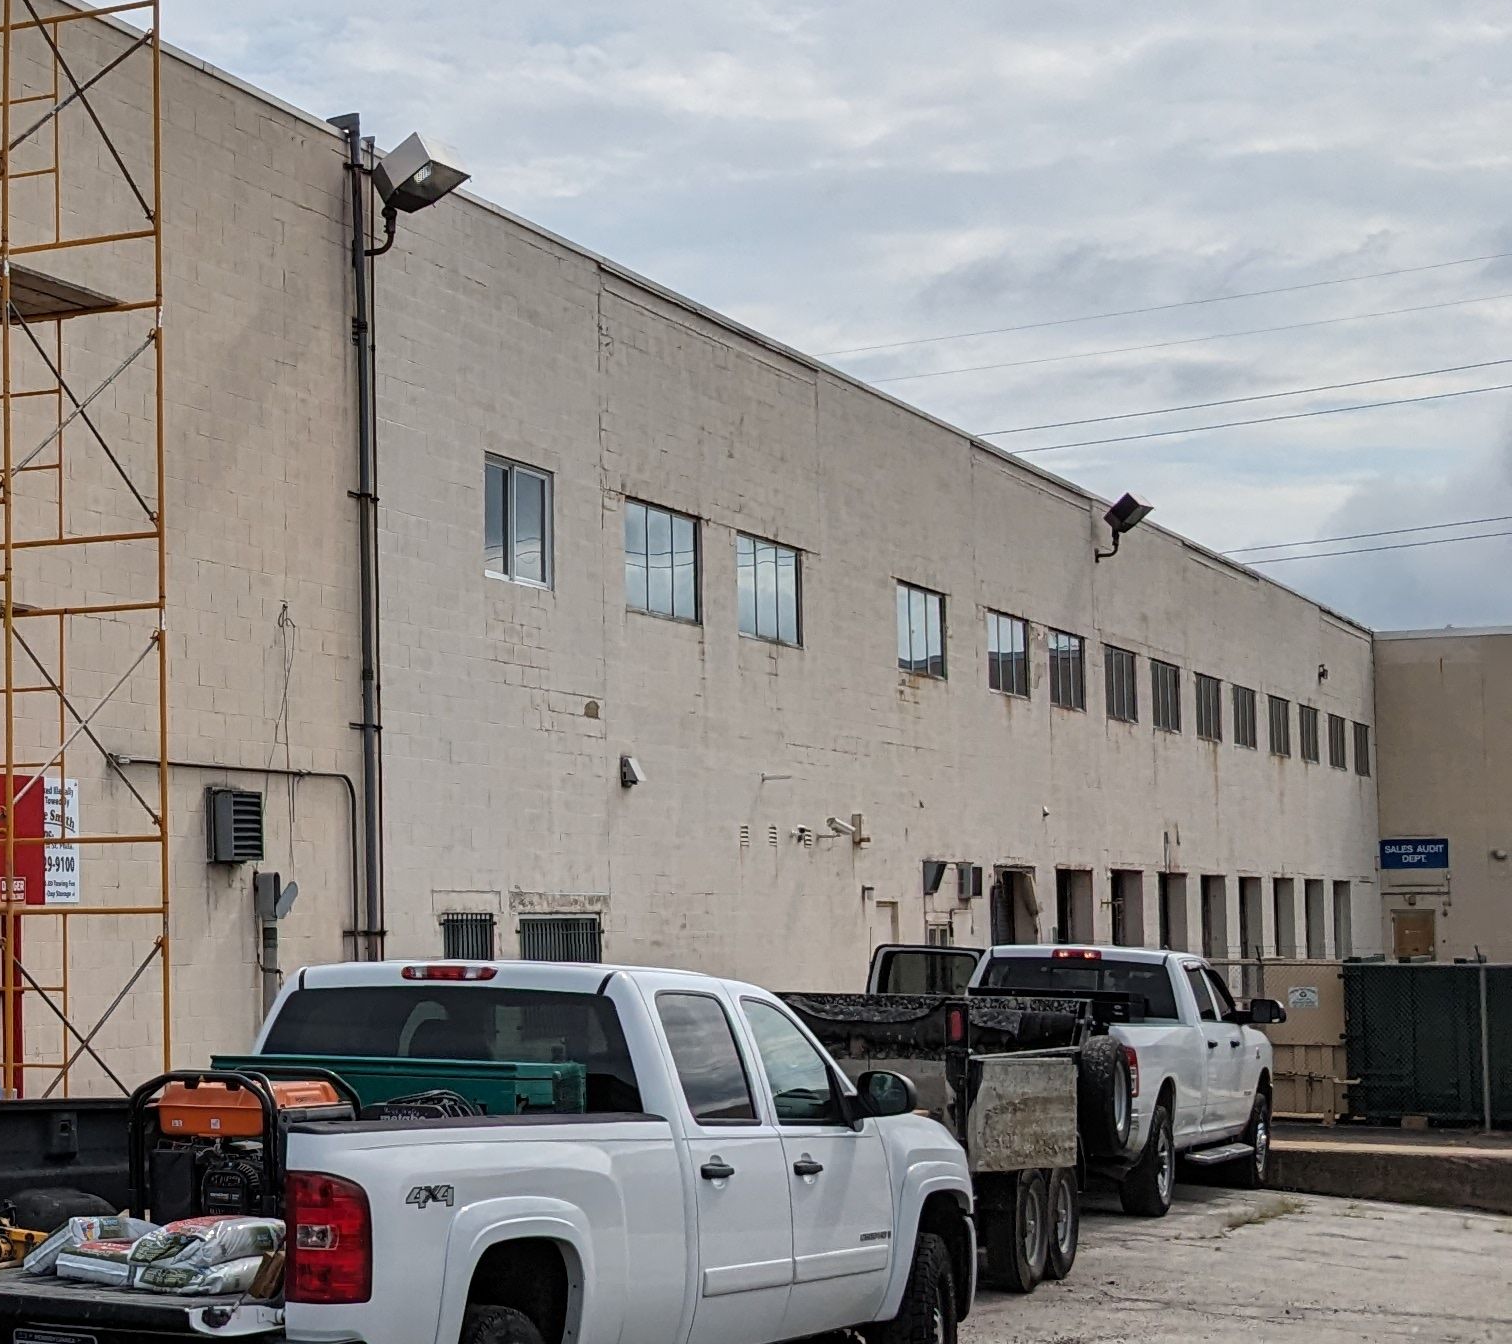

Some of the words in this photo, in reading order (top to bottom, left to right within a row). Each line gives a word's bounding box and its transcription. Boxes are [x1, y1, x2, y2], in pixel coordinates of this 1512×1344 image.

[53, 786, 74, 798] Illeally
[50, 809, 75, 829] Smth
[1384, 845, 1414, 853] SALES
[1416, 844, 1444, 852] AUDIT
[44, 855, 75, 872] 29-9100
[1, 880, 25, 891] DGER
